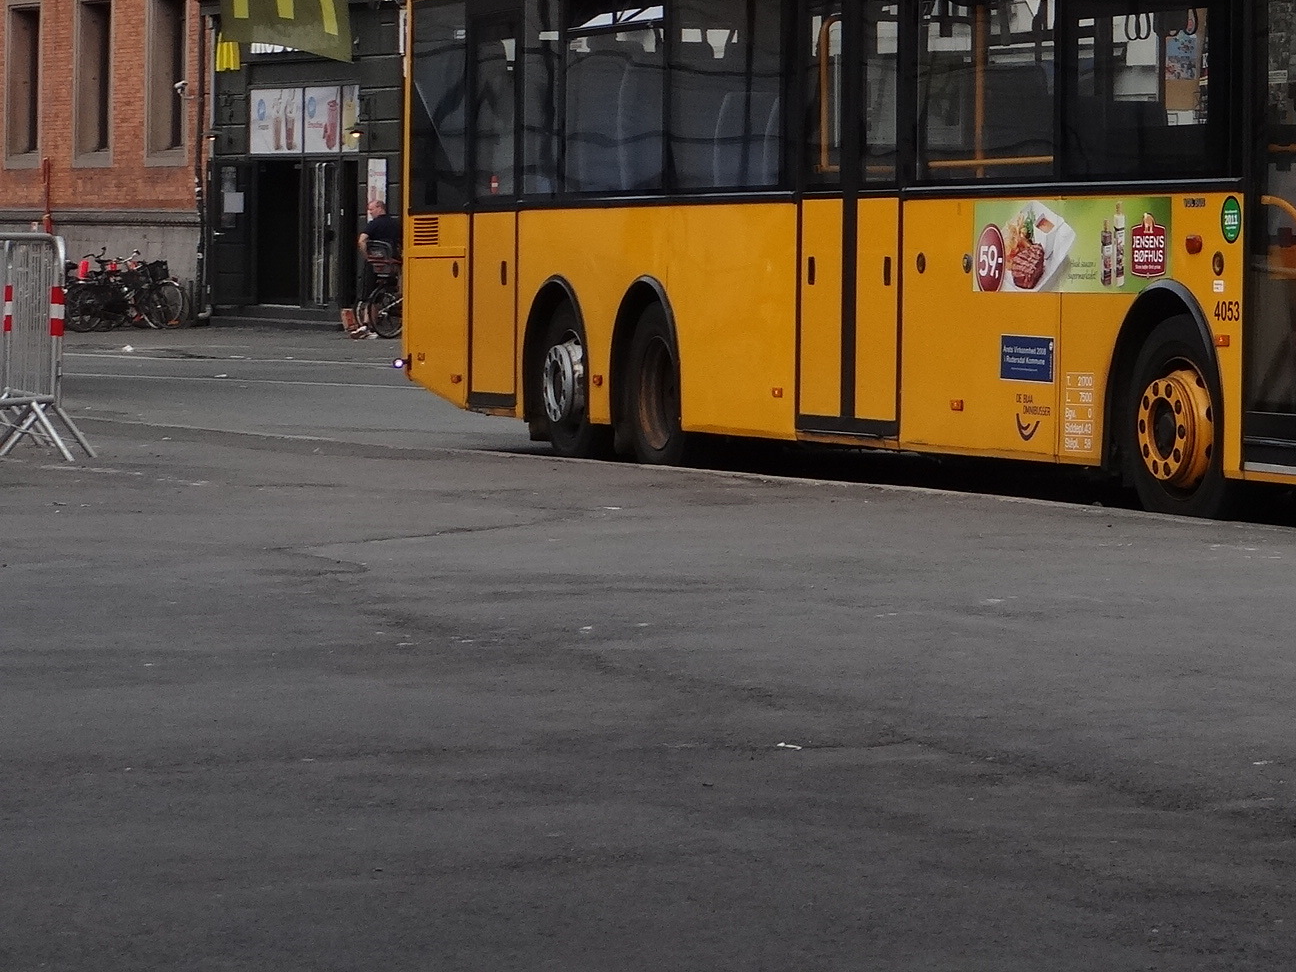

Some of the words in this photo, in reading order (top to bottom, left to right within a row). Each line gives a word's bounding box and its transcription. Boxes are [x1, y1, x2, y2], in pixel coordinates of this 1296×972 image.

[1224, 214, 1238, 225] 2011
[1132, 235, 1165, 248] JENSEN'S
[979, 245, 1003, 279] 59,-
[1133, 250, 1164, 263] BØFHUS
[1214, 301, 1240, 322] 4053
[1016, 394, 1022, 403] DE
[1023, 406, 1051, 416] OMNIBUSSER
